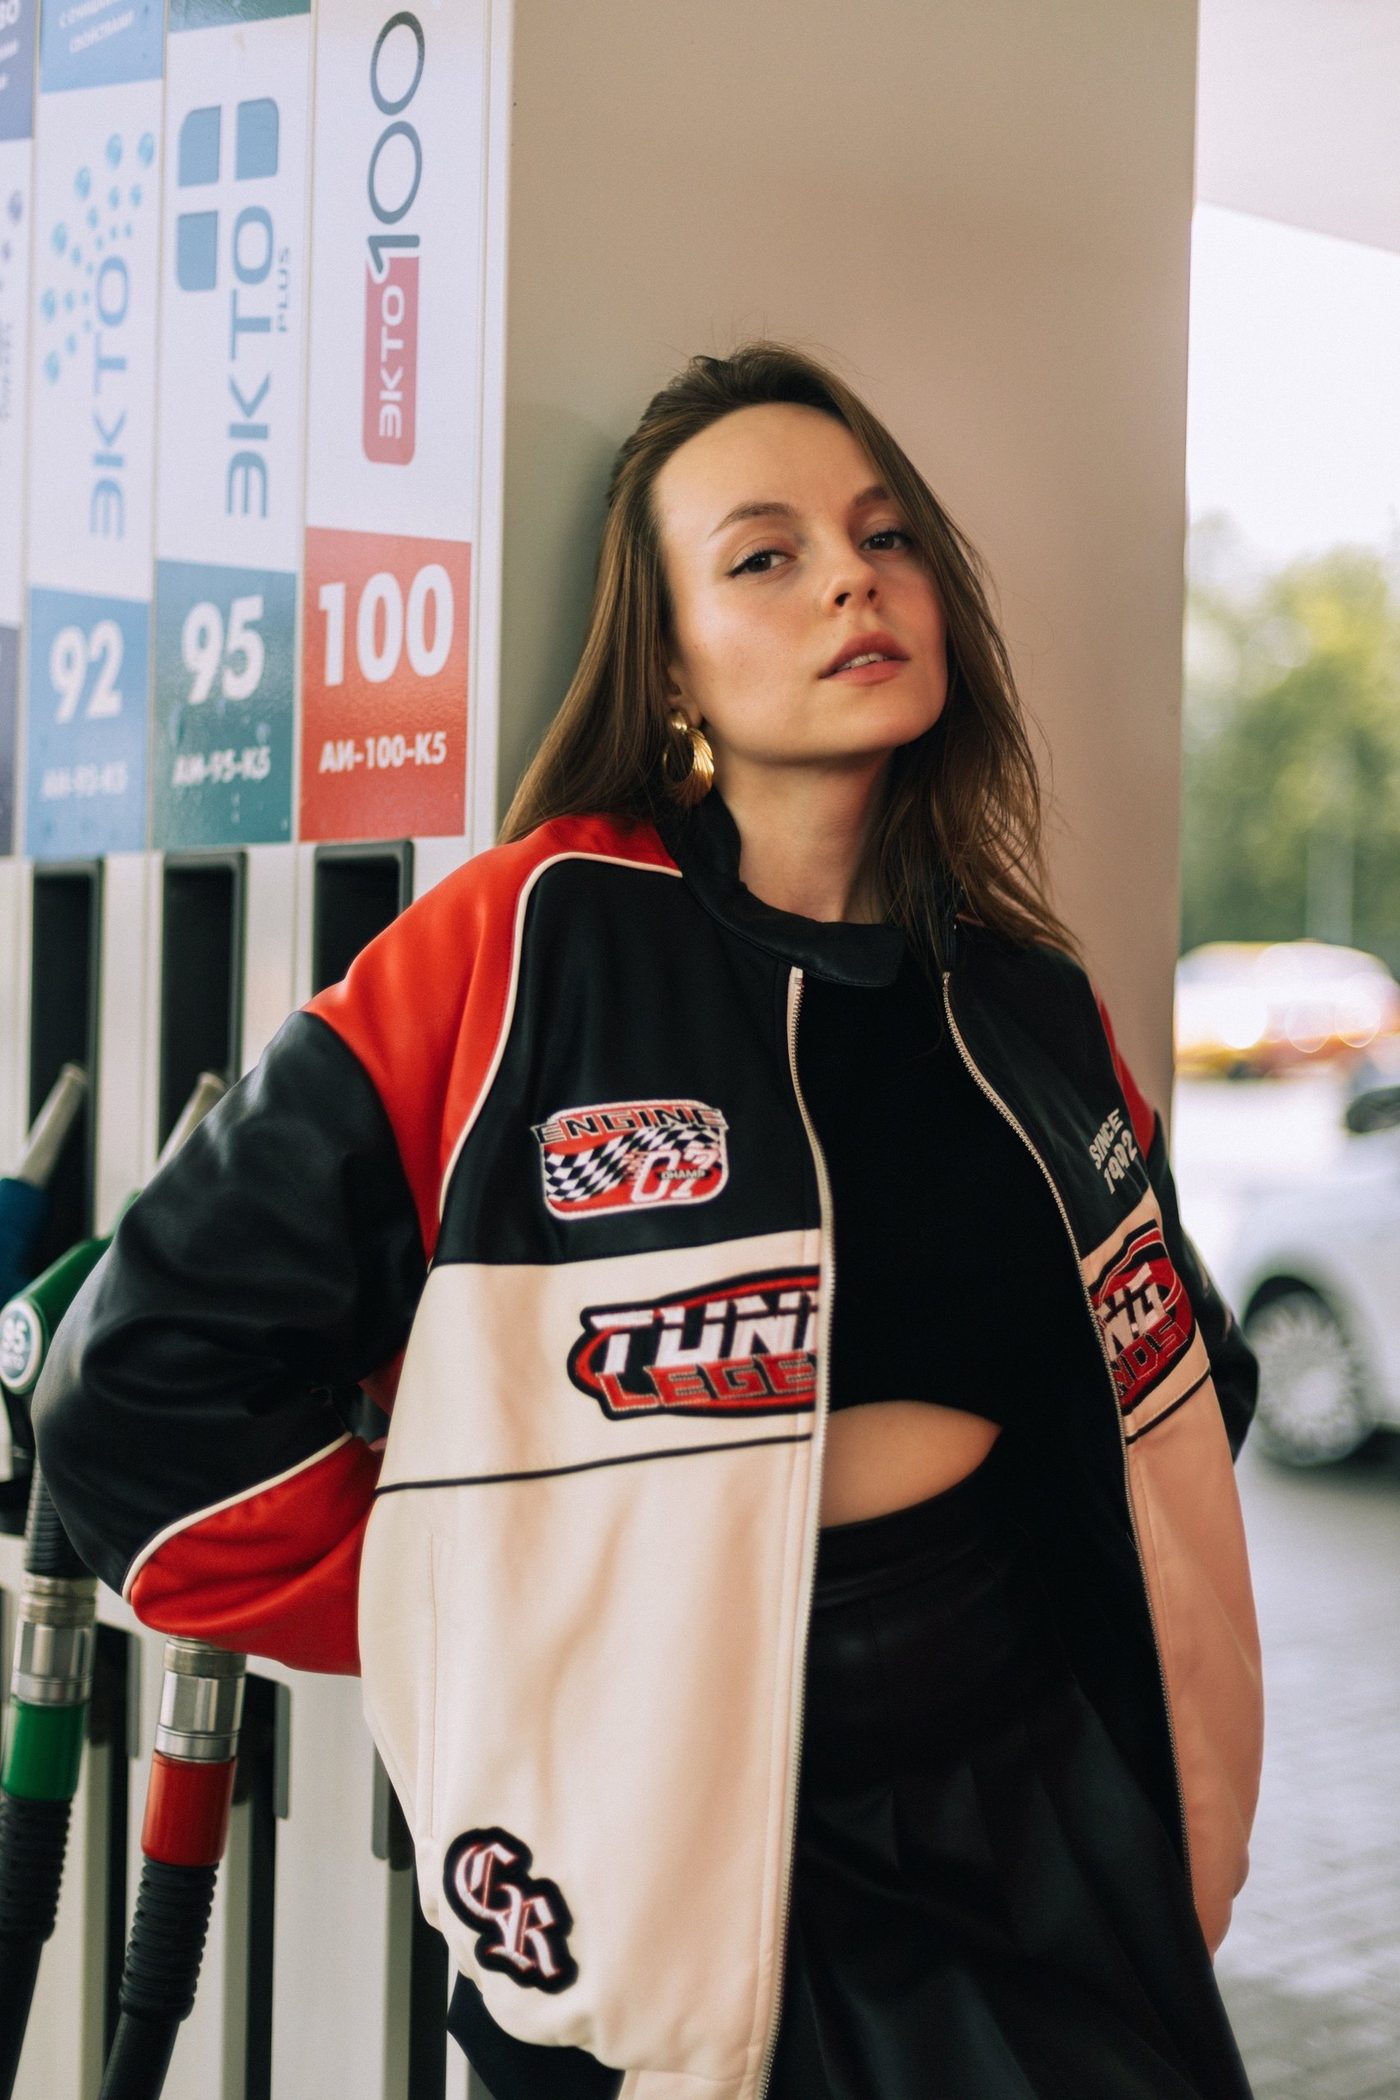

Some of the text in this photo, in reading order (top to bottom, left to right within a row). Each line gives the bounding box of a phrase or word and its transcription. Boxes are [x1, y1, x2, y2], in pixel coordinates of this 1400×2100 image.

[367, 11, 426, 275] 100
[90, 256, 130, 540] ЭКТО
[226, 205, 274, 520] ЭКТО
[49, 620, 124, 724] 92
[180, 595, 265, 705] 95
[319, 563, 455, 686] 100
[318, 732, 447, 774] АИ-100-К5
[532, 1105, 729, 1145] ENGINE
[1089, 1108, 1124, 1170] SINCE
[1103, 1130, 1138, 1195] 1992
[598, 1350, 817, 1411] LEGE
